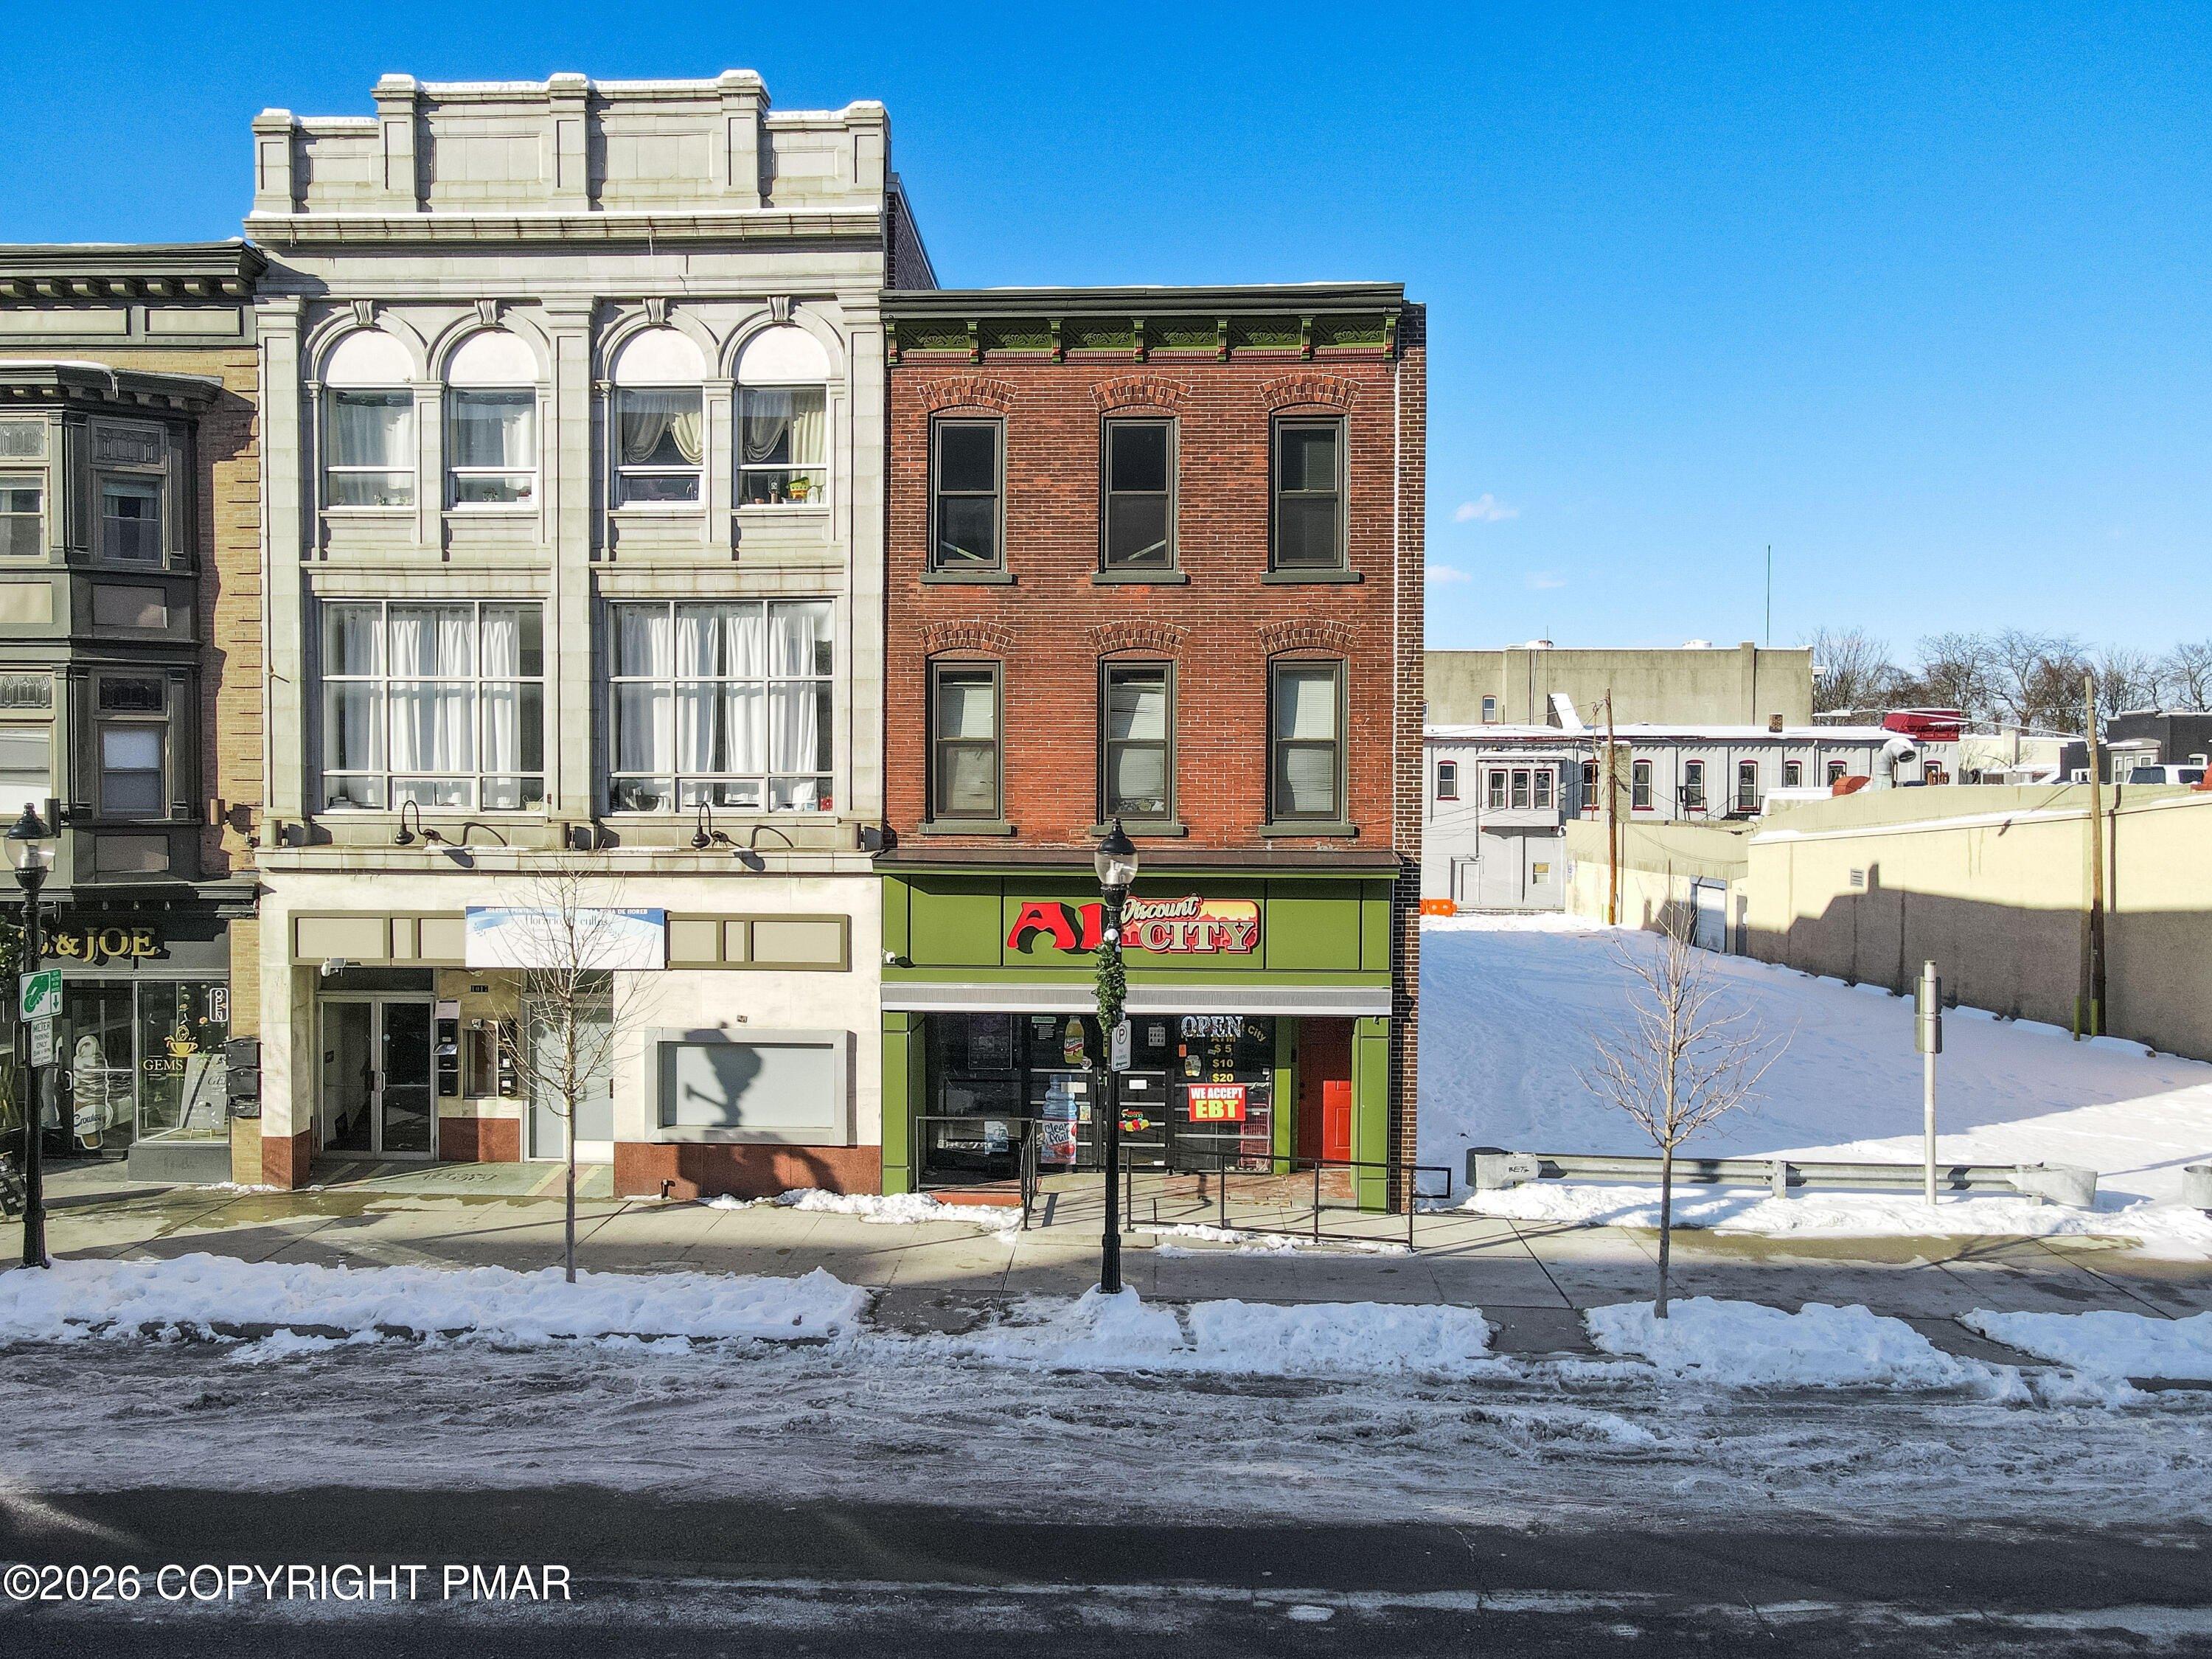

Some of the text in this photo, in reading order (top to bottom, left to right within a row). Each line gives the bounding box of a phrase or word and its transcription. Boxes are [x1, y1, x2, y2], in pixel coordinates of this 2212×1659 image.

[1121, 897, 1200, 924] Discount
[1141, 921, 1254, 950] CITY
[56, 933, 79, 956] &
[83, 928, 158, 963] JOE
[215, 990, 223, 1020] OPEN
[33, 1022, 51, 1032] METER
[1181, 1015, 1243, 1038] OPEN
[1248, 1025, 1267, 1043] City
[1119, 1029, 1125, 1041] P
[143, 1059, 183, 1071] GEMS
[1212, 1059, 1234, 1068] $10
[1211, 1073, 1234, 1083] $20
[1190, 1087, 1245, 1099] WE ACCEPT
[1195, 1099, 1239, 1119] EBT
[1049, 1129, 1070, 1144] fruit
